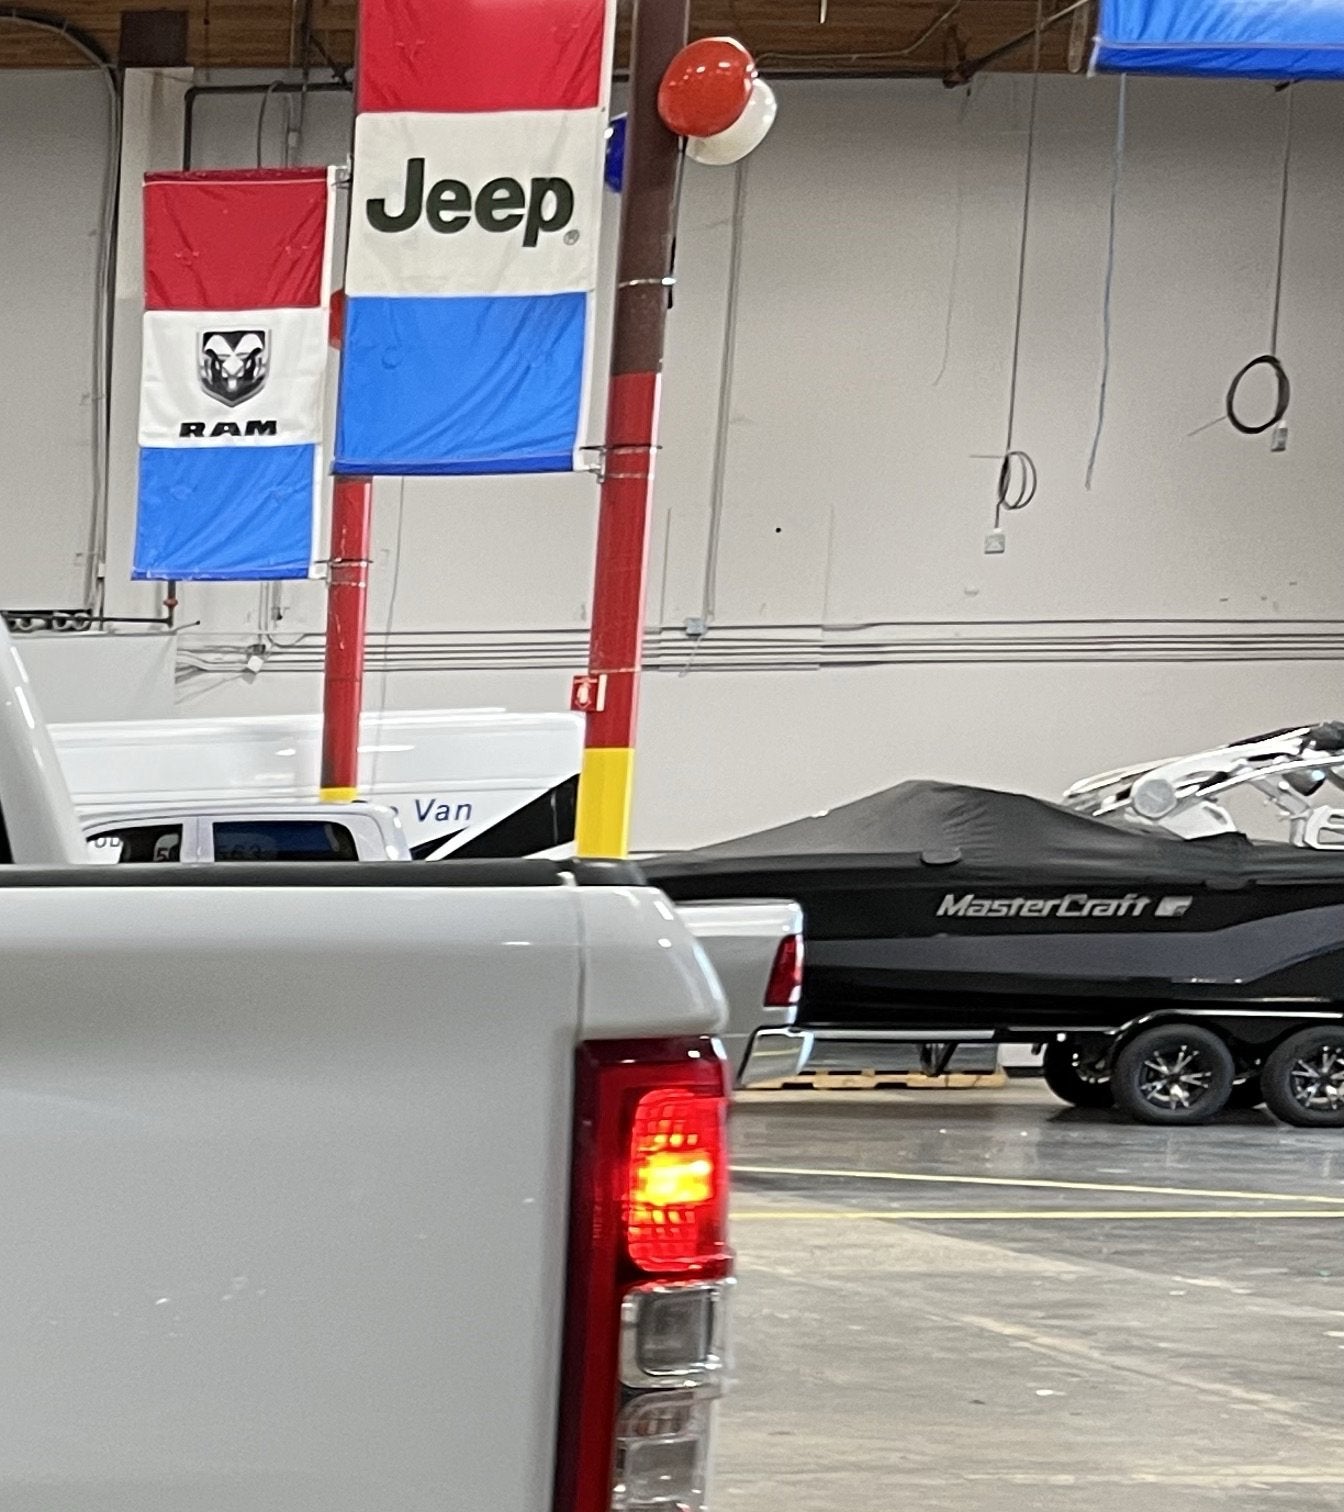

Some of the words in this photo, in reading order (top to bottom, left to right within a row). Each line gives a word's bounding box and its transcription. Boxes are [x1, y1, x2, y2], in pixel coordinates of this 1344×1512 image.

[366, 157, 575, 247] Jeep
[179, 420, 278, 438] RAM
[414, 798, 473, 822] Van
[936, 894, 1150, 917] MasterCraft
